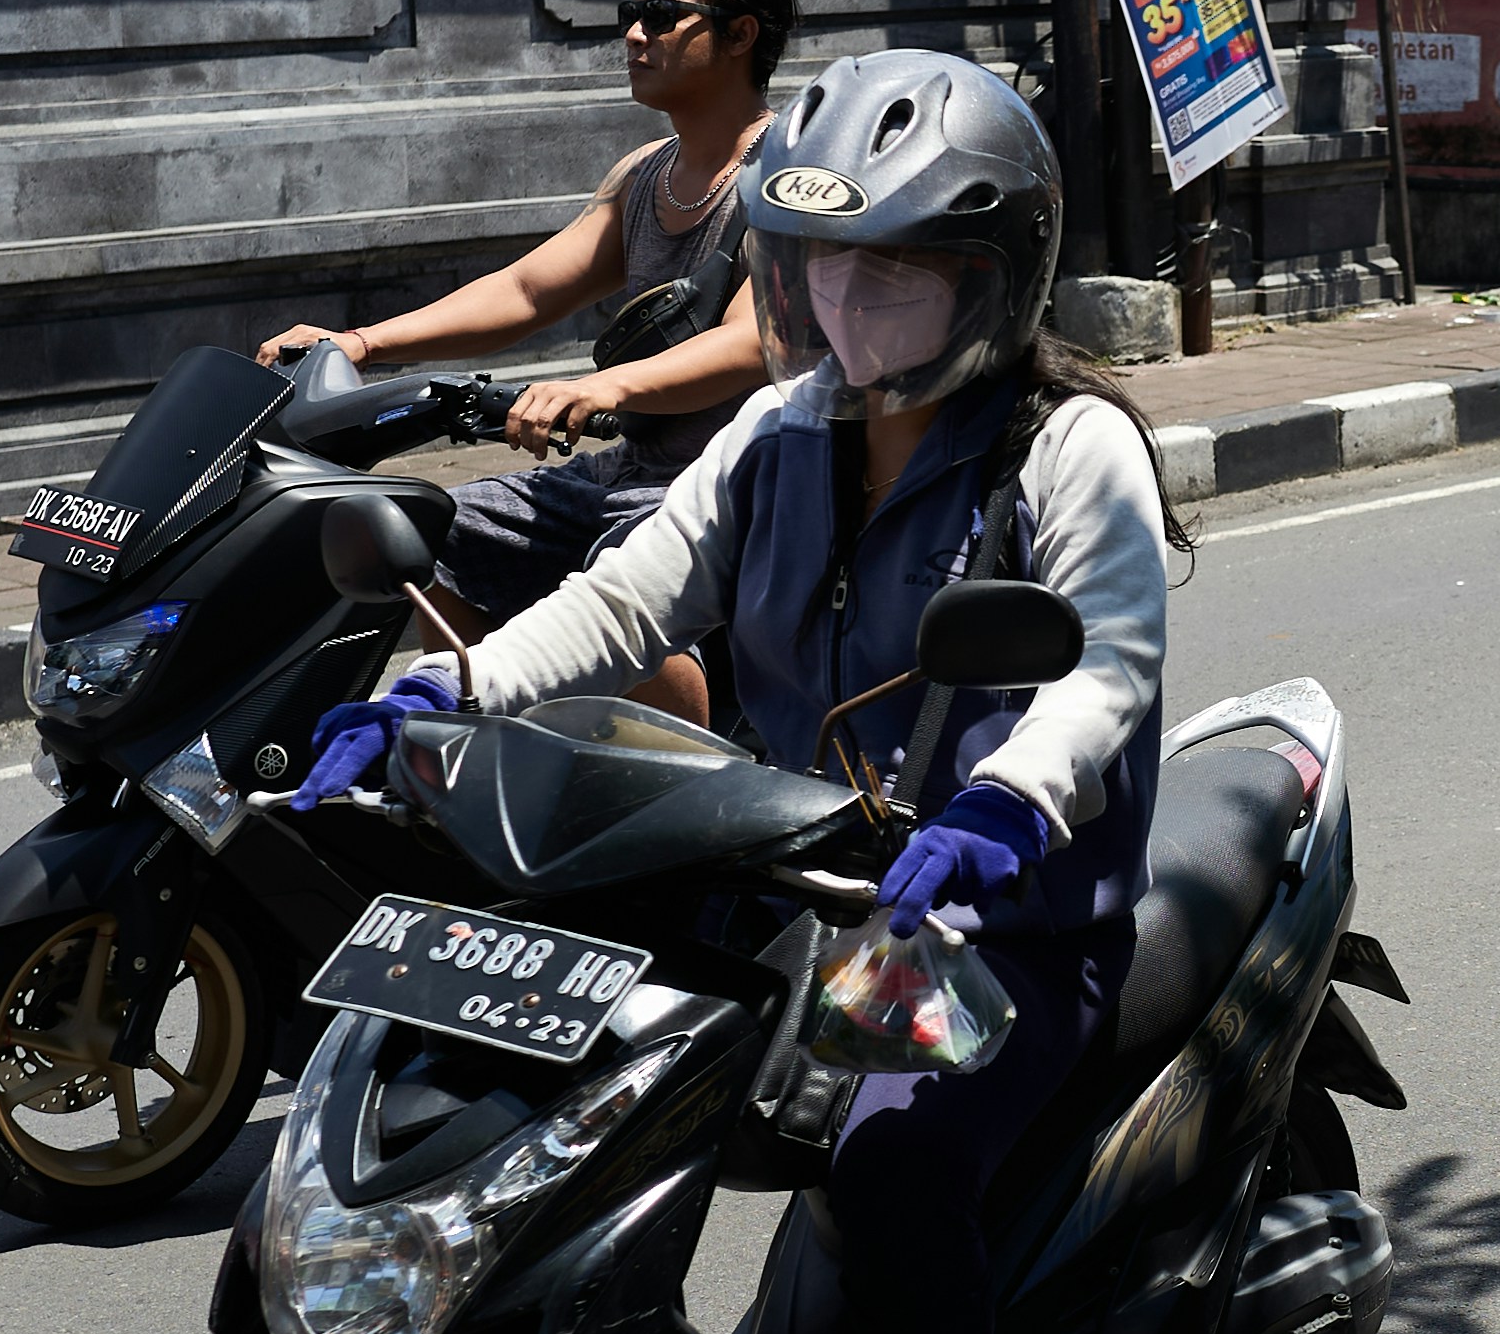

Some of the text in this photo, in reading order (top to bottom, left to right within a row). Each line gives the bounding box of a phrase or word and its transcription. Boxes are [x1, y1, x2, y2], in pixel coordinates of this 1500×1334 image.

[1159, 73, 1189, 99] GRATIS
[25, 487, 60, 521] DK
[350, 905, 428, 953] DK
[428, 920, 556, 980] 3688
